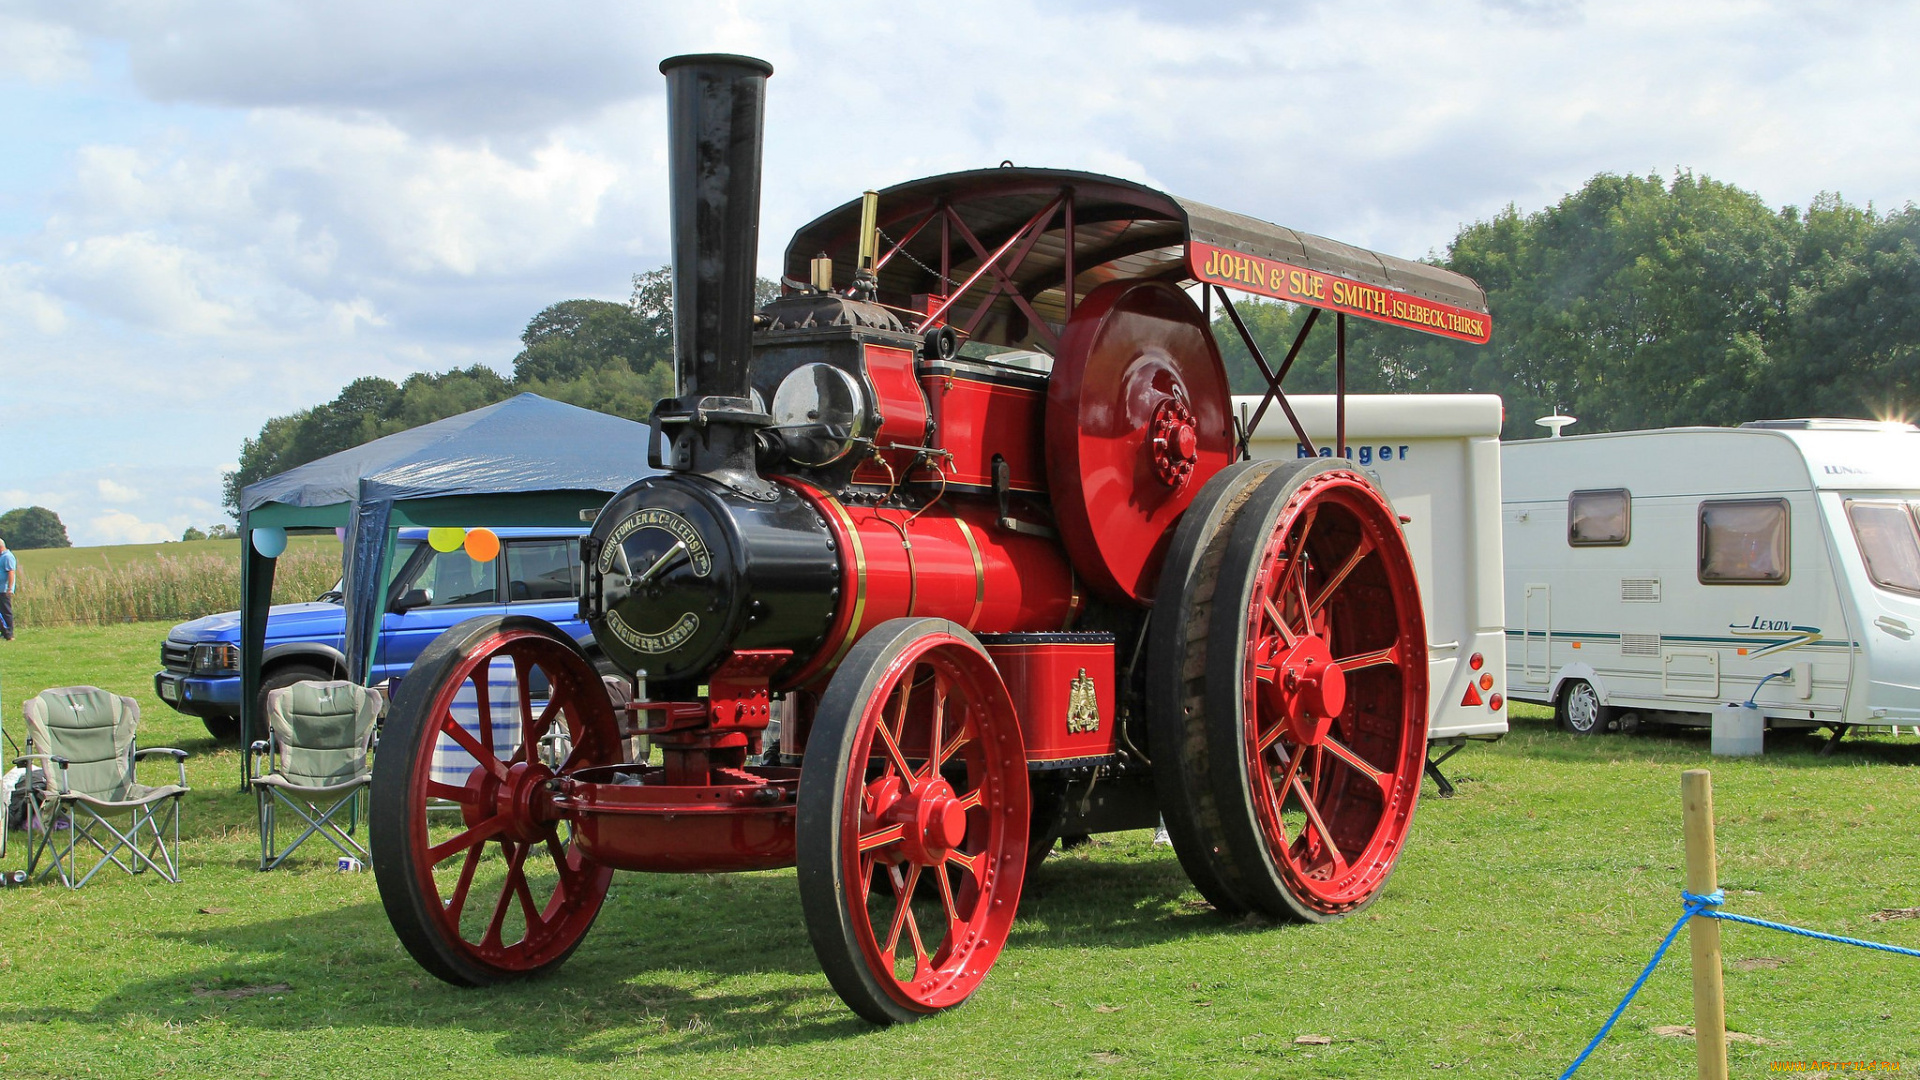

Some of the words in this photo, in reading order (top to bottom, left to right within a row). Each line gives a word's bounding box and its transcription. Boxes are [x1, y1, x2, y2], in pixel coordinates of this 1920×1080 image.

[1205, 250, 1265, 286] JOHN
[1270, 268, 1285, 290] &
[1289, 270, 1325, 300] SUE
[1332, 281, 1390, 317] SMITH,
[1393, 299, 1448, 330] ISLEBECK,
[1447, 313, 1485, 338] THIRSK
[1824, 465, 1872, 475] LUNA
[602, 536, 618, 565] JOHN
[614, 513, 648, 541] FOWLER
[649, 512, 657, 523] &
[669, 518, 702, 553] (LEEDS)
[661, 619, 694, 647] LEEDS
[1750, 615, 1792, 631] LEXON
